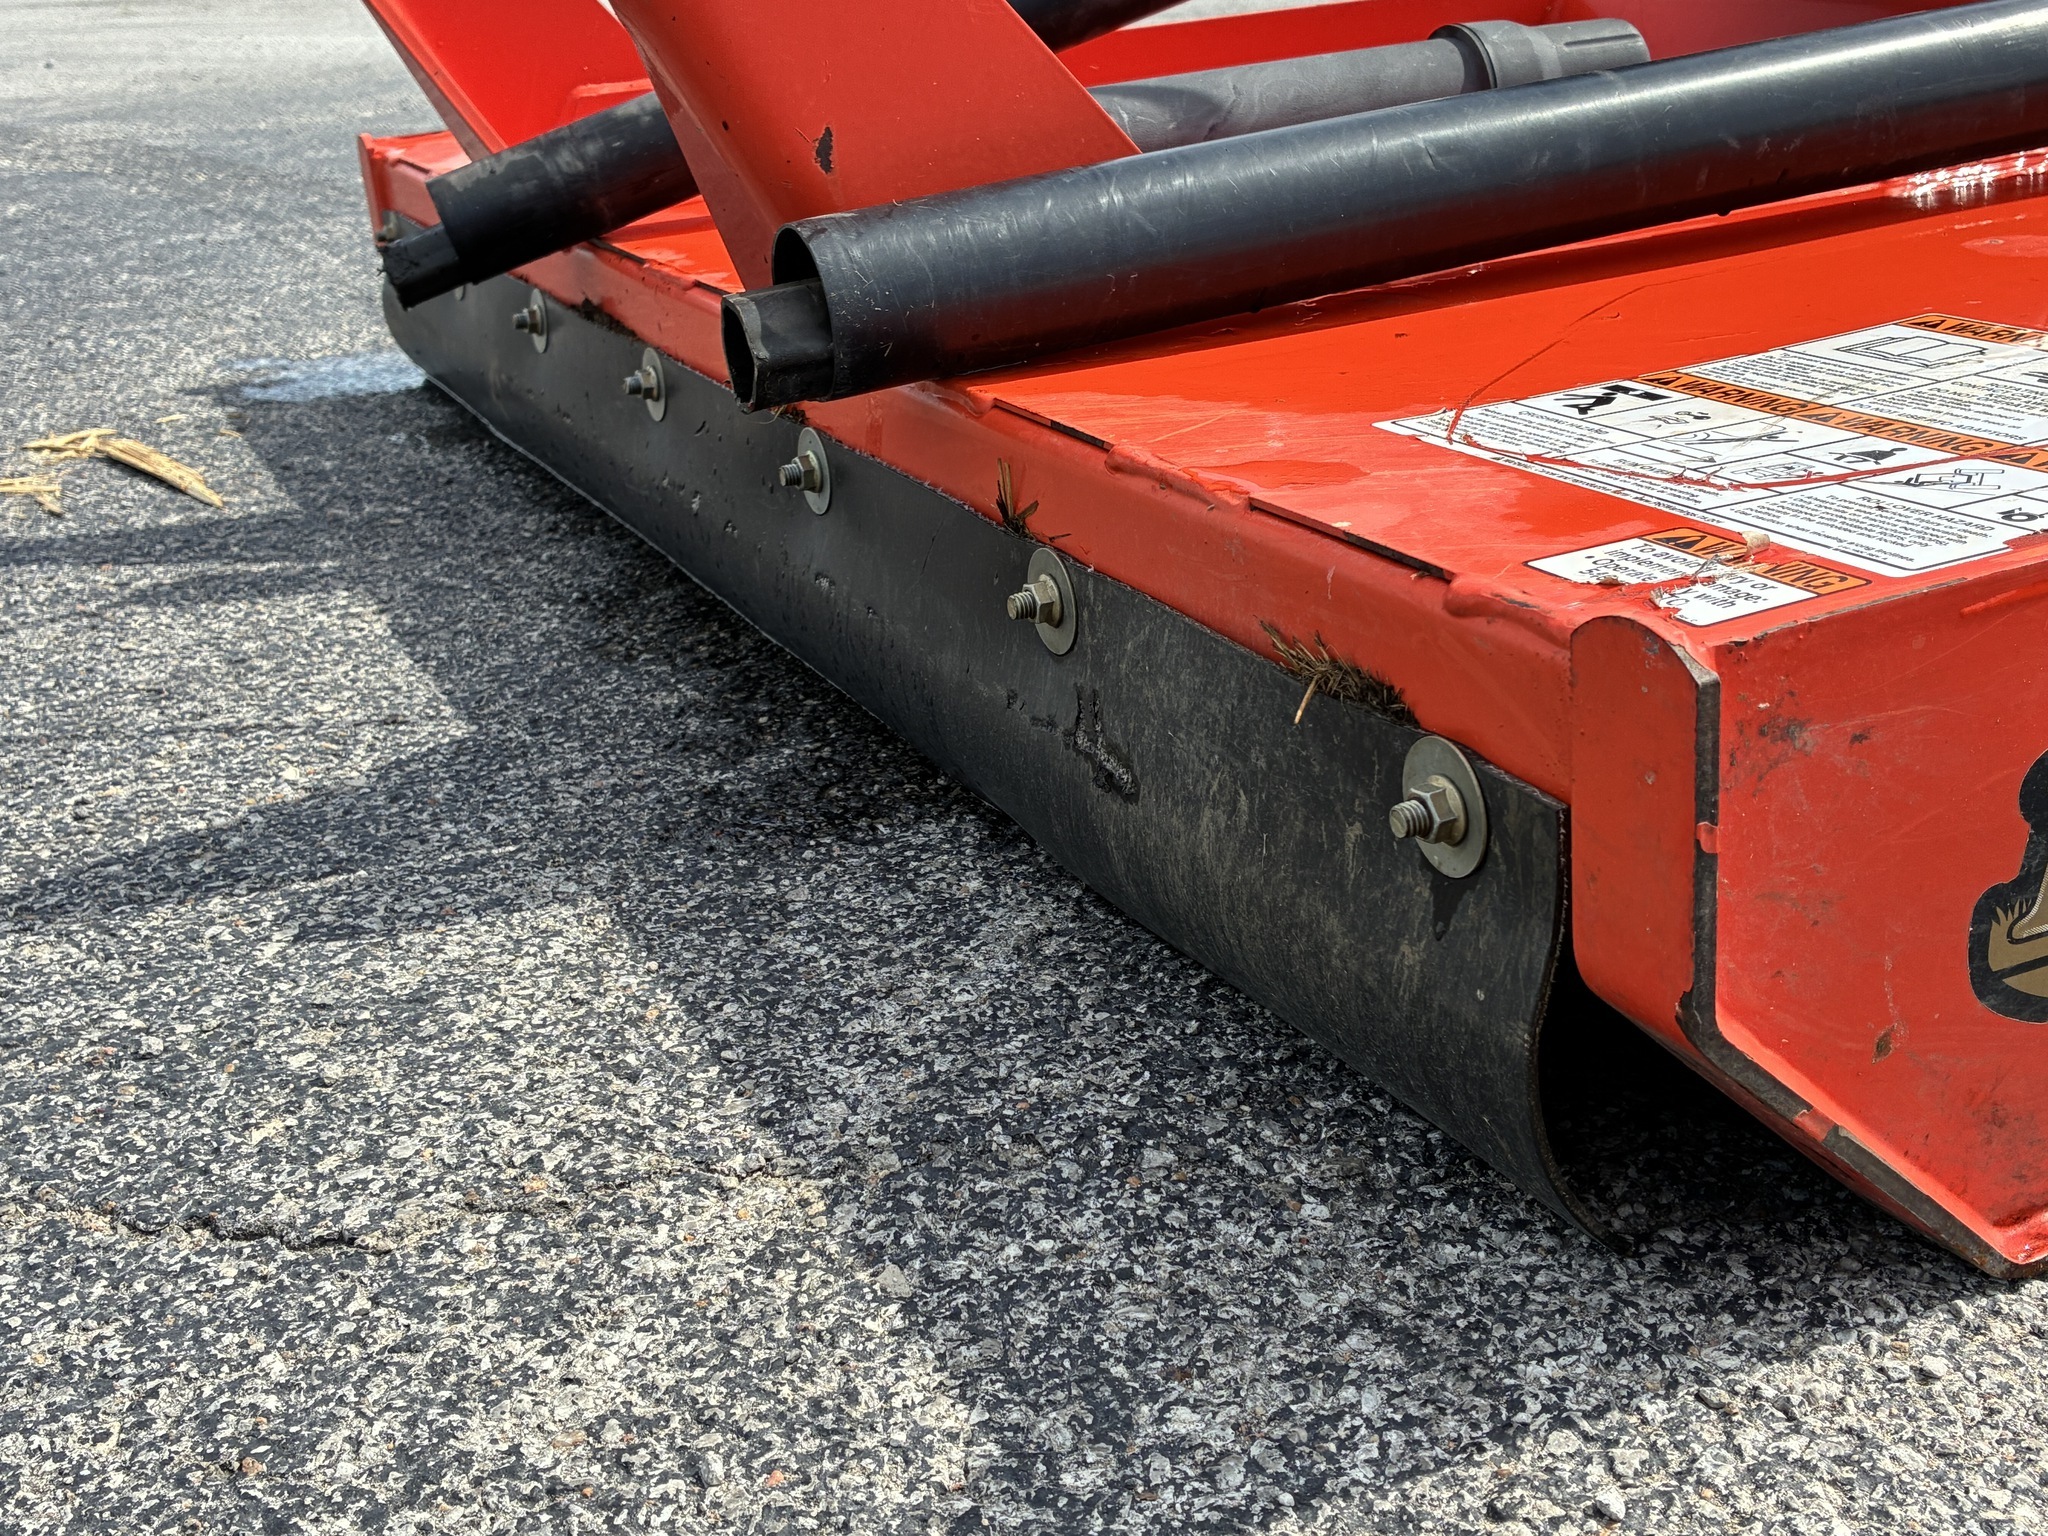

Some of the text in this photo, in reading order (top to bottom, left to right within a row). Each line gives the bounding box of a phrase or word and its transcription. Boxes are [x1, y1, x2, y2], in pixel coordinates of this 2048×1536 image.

[1675, 381, 1807, 412] WARNING
[1977, 397, 2039, 410] OPERATE
[1836, 417, 1992, 452] WARNING
[1952, 425, 2027, 440] ADAPTORS
[1805, 496, 1836, 505] Always
[1894, 519, 1920, 527] when
[1857, 496, 1995, 531] ROLLOVER HAZARD
[1913, 517, 1944, 526] injury
[1752, 515, 1785, 525] caution
[1785, 524, 1810, 532] when
[1809, 531, 1847, 543] mowing
[1846, 542, 1875, 551] along
[1631, 543, 1656, 553] To
[1652, 552, 1710, 568] avoid
[1592, 558, 1736, 608] Operate with
[1604, 550, 1768, 602] implemen amage:
